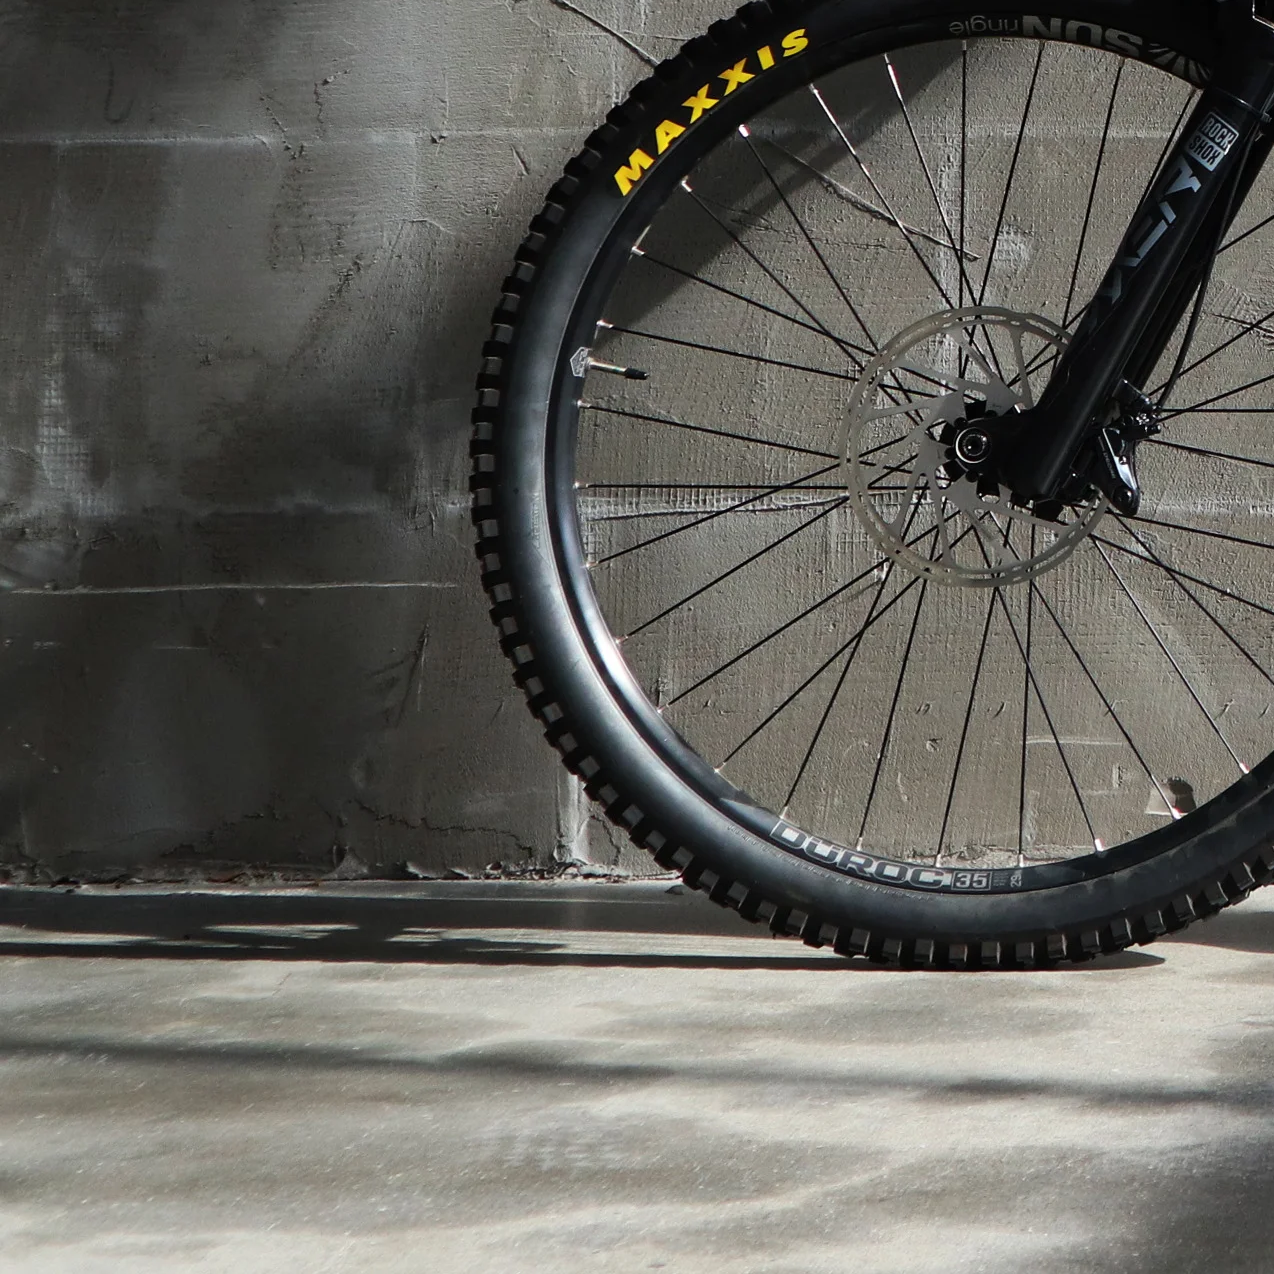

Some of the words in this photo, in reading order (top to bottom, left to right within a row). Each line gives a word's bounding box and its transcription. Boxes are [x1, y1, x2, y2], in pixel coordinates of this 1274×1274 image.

[1022, 15, 1143, 57] SUN
[614, 28, 809, 196] MAXXIS
[1189, 135, 1224, 165] SHOX
[1201, 117, 1237, 150] ROCK
[955, 873, 988, 889] 35
